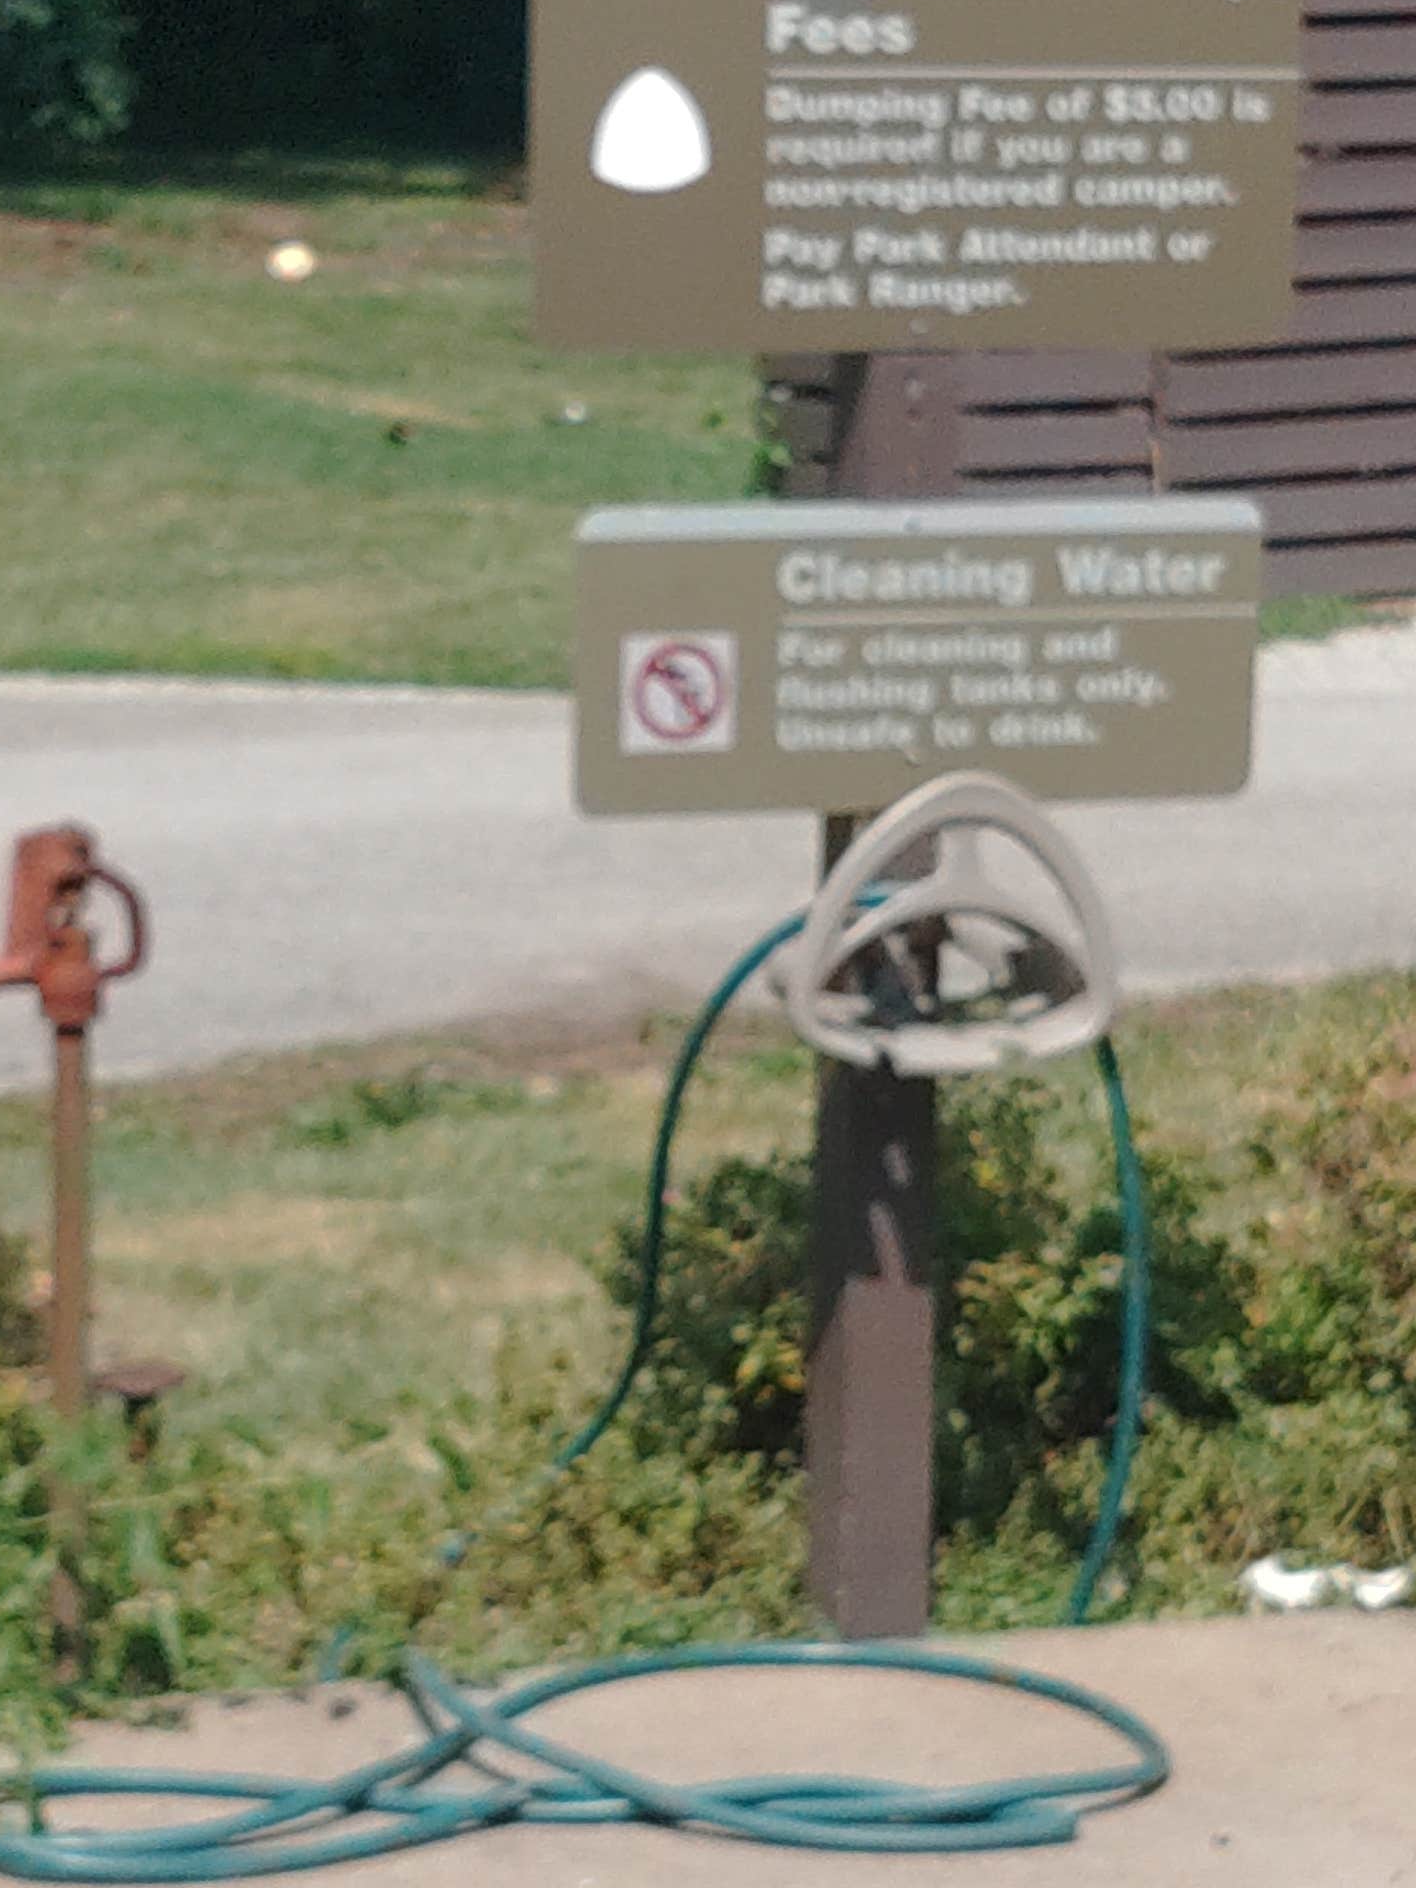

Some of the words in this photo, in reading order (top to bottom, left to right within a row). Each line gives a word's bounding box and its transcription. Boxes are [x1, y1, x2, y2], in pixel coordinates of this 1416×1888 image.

[765, 3, 915, 56] Fees
[764, 84, 948, 130] Dumping
[956, 85, 1035, 123] Fee
[1044, 86, 1090, 123] of
[995, 137, 1069, 171] you
[1082, 134, 1146, 163] are
[762, 228, 844, 272] Pay
[853, 228, 946, 266] Park
[958, 224, 1158, 266] Attendant
[761, 272, 856, 310] Park
[780, 550, 1034, 608] Cleaning
[1056, 545, 1228, 595] Water
[776, 633, 846, 668] For
[1042, 626, 1120, 663] and
[933, 716, 975, 748] to
